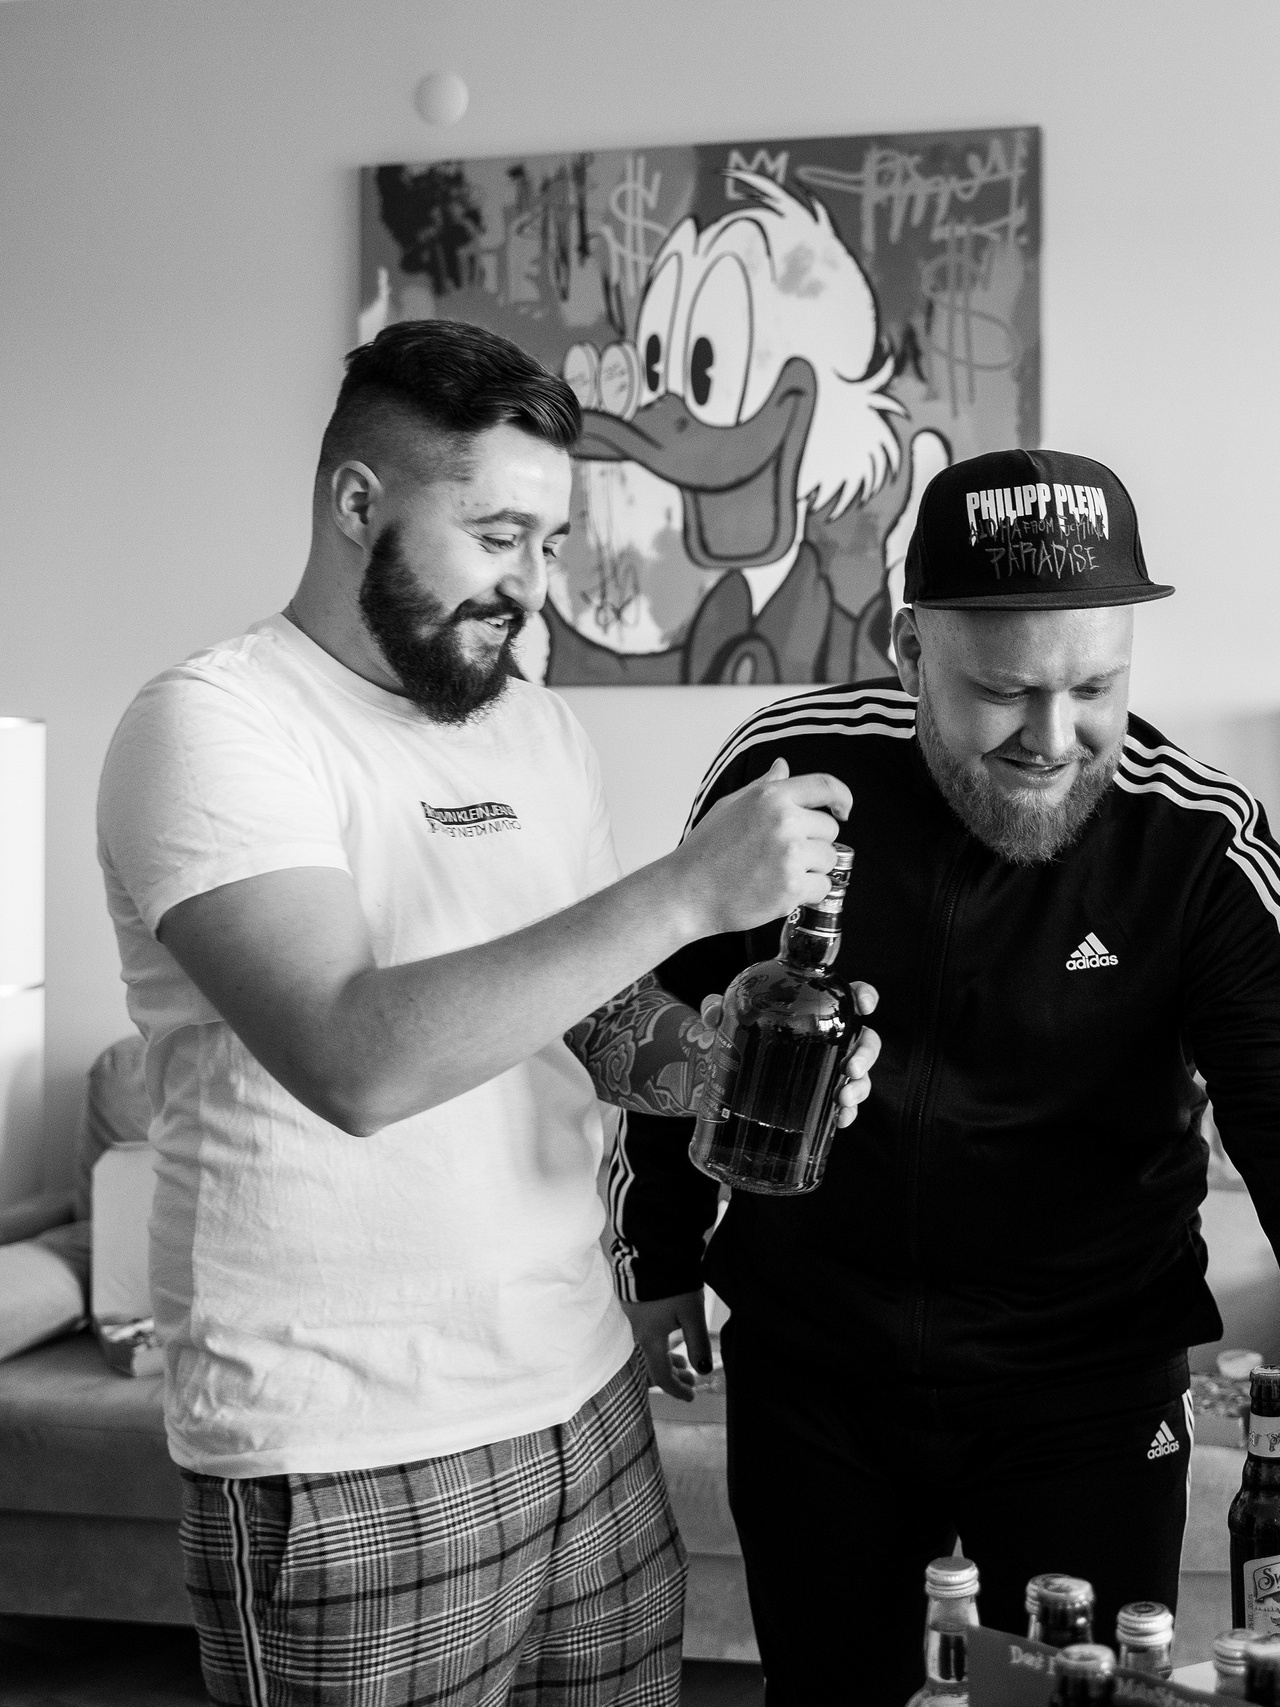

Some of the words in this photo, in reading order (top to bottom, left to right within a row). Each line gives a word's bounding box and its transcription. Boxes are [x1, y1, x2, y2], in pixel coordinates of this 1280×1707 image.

[966, 483, 1051, 536] PHILIPP
[1053, 483, 1109, 537] PLEIN
[1023, 516, 1055, 534] FROM
[1065, 954, 1119, 971] adidas
[1147, 1440, 1180, 1460] adidas
